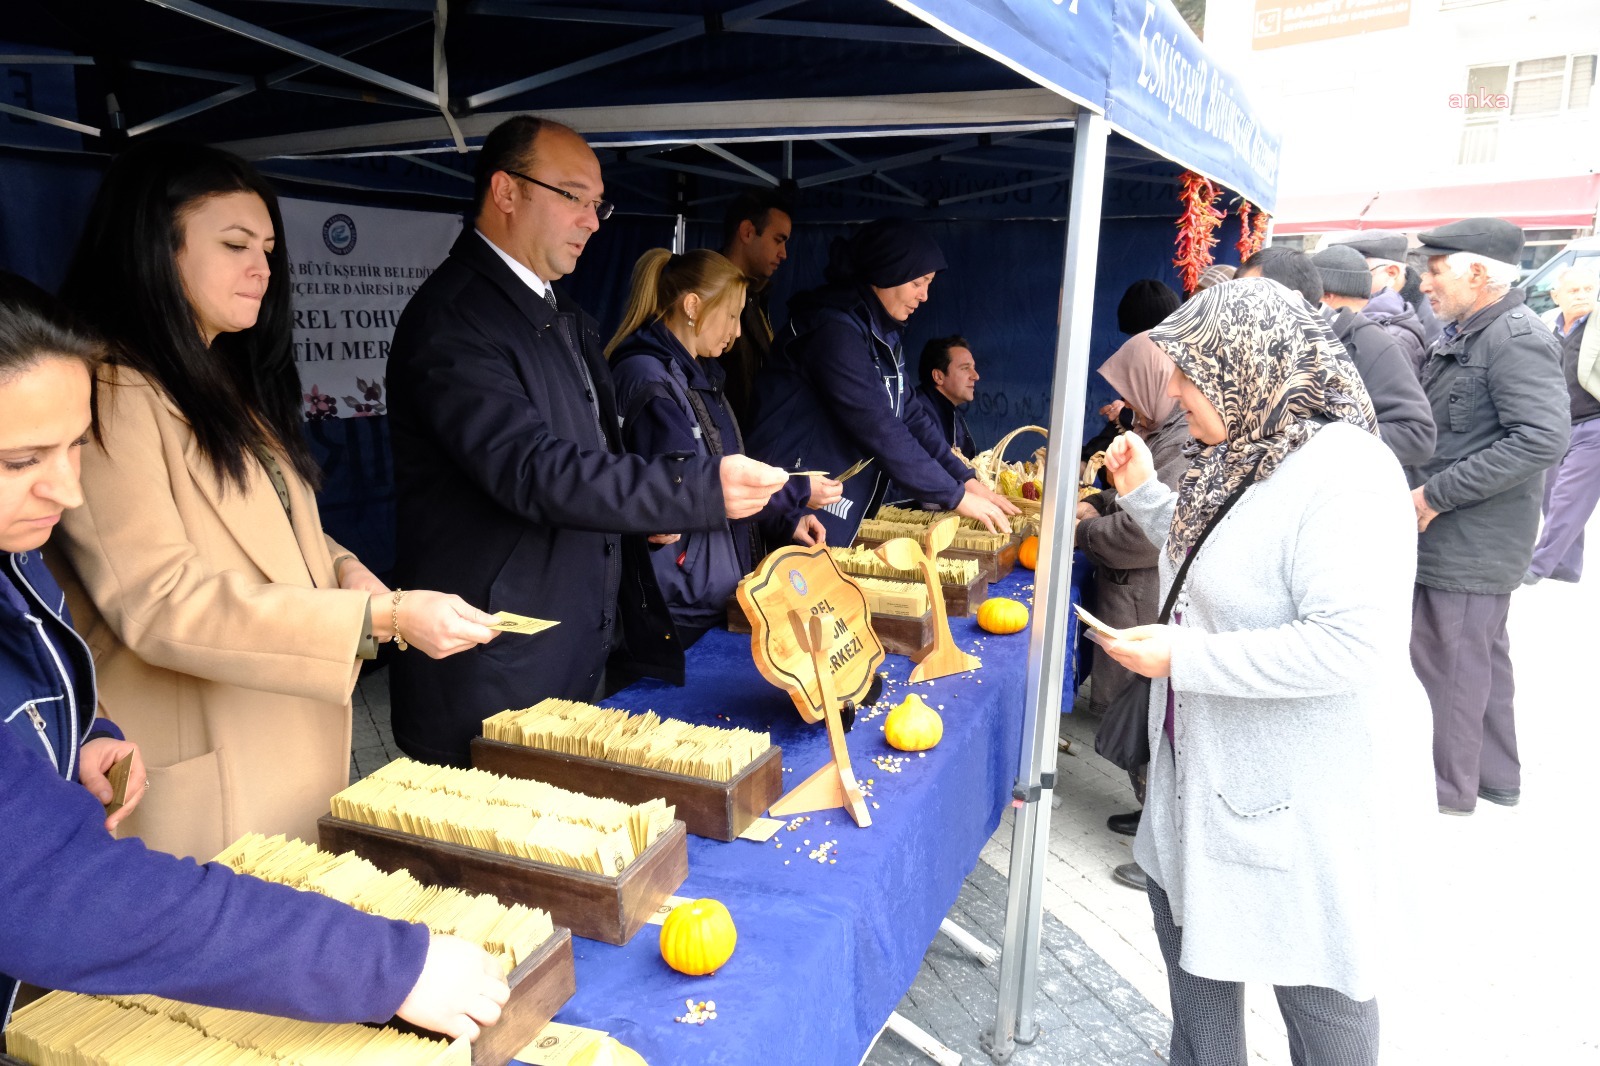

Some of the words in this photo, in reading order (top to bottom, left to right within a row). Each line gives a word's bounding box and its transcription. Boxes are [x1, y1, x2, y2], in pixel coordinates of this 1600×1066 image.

[1137, 1, 1207, 129] ESKİŞEHİR
[299, 261, 381, 279] BÜYÜKŞEHİR
[344, 282, 394, 296] DAİRESİ
[292, 309, 337, 329] REL
[341, 309, 400, 329] TOHU
[293, 338, 334, 362] TİM
[341, 340, 391, 360] MER
[810, 599, 835, 615] REL
